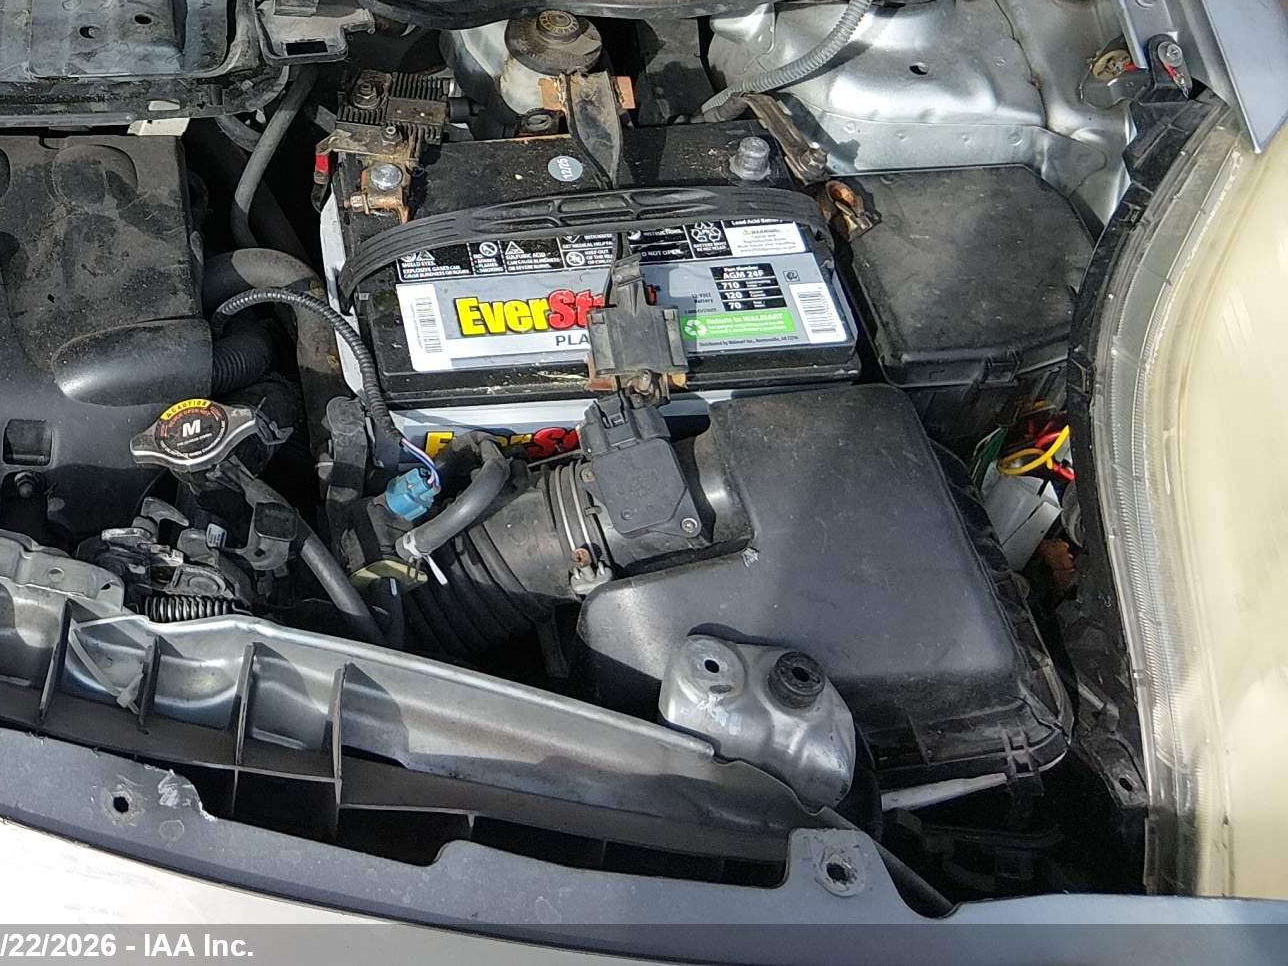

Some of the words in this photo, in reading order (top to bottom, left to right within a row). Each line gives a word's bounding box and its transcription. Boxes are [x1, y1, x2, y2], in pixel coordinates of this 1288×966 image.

[723, 270, 746, 279] AGM
[721, 281, 741, 290] 710
[724, 291, 743, 299] 120
[728, 301, 742, 310] 70
[455, 289, 605, 337] EverSt
[706, 317, 732, 325] Return
[743, 313, 783, 322] WALMART
[172, 400, 208, 414] CAUTION
[183, 419, 201, 438] M
